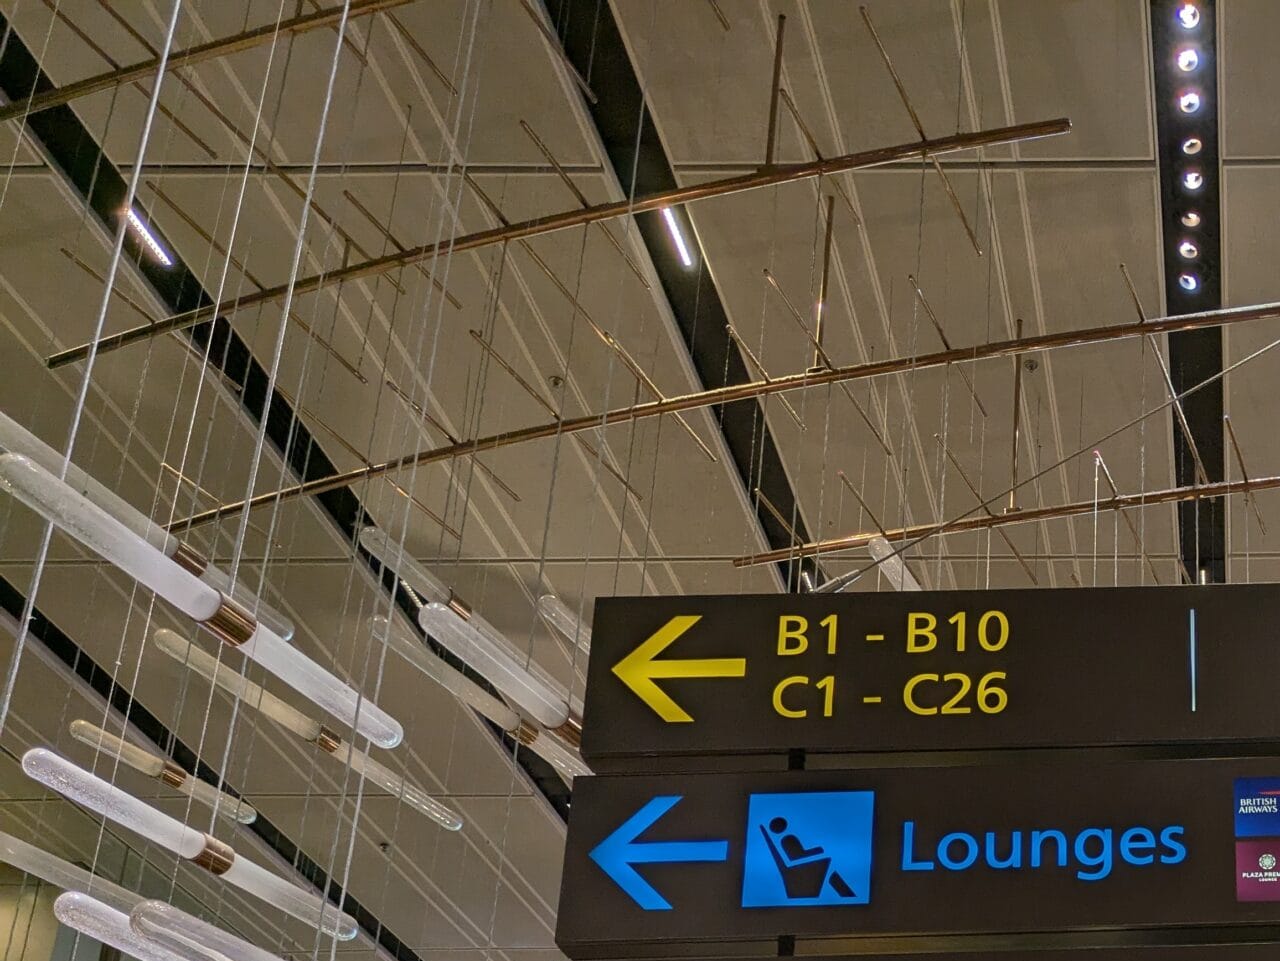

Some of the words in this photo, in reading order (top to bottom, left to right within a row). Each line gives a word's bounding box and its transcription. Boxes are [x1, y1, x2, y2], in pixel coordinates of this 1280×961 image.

[777, 614, 838, 656] B1
[906, 610, 1010, 653] B10
[772, 675, 835, 718] C1
[903, 671, 1008, 716] C26
[1239, 805, 1278, 814] AIRWAYS
[1240, 798, 1277, 806] BRITISH
[902, 820, 1187, 881] Lounges
